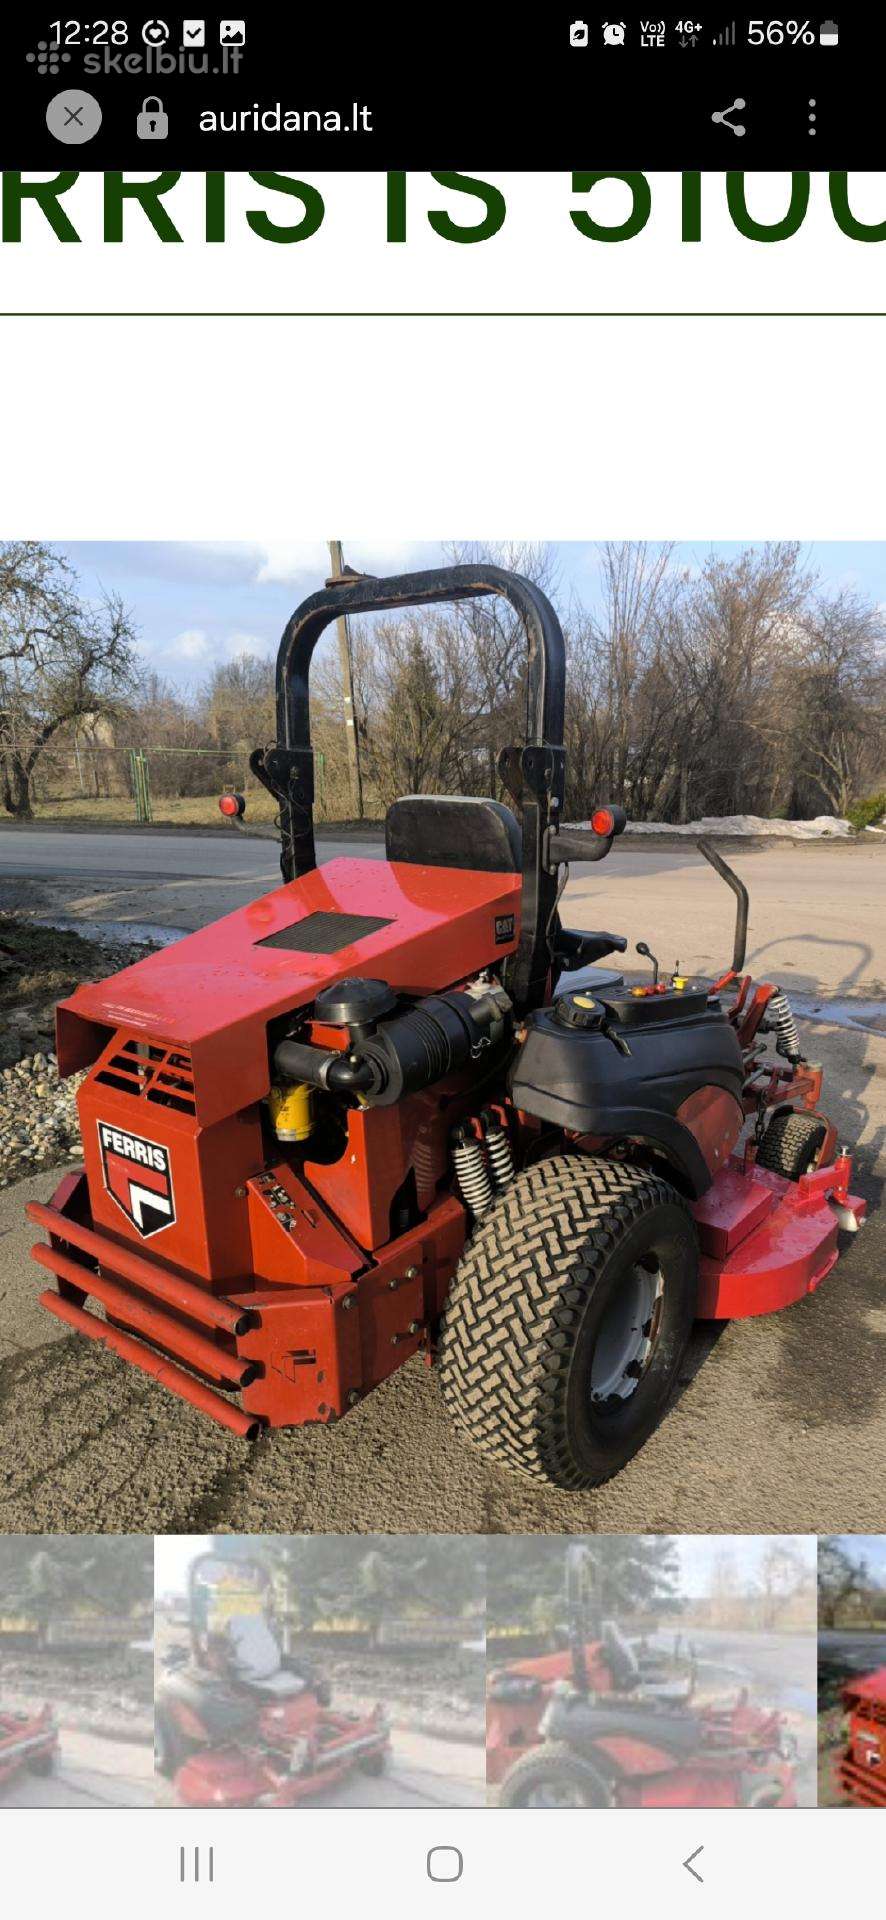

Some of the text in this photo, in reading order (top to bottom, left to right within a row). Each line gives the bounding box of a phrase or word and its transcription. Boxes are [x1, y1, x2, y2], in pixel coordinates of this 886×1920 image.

[49, 20, 129, 45] 12:28
[675, 21, 703, 34] 4G+
[747, 20, 816, 45] 56%
[640, 34, 665, 47] LTE
[199, 102, 373, 132] auridana.lt
[2, 172, 325, 243] RRIS
[387, 172, 506, 243] IS
[496, 917, 513, 935] CAT
[101, 1126, 167, 1171] FERRIS
